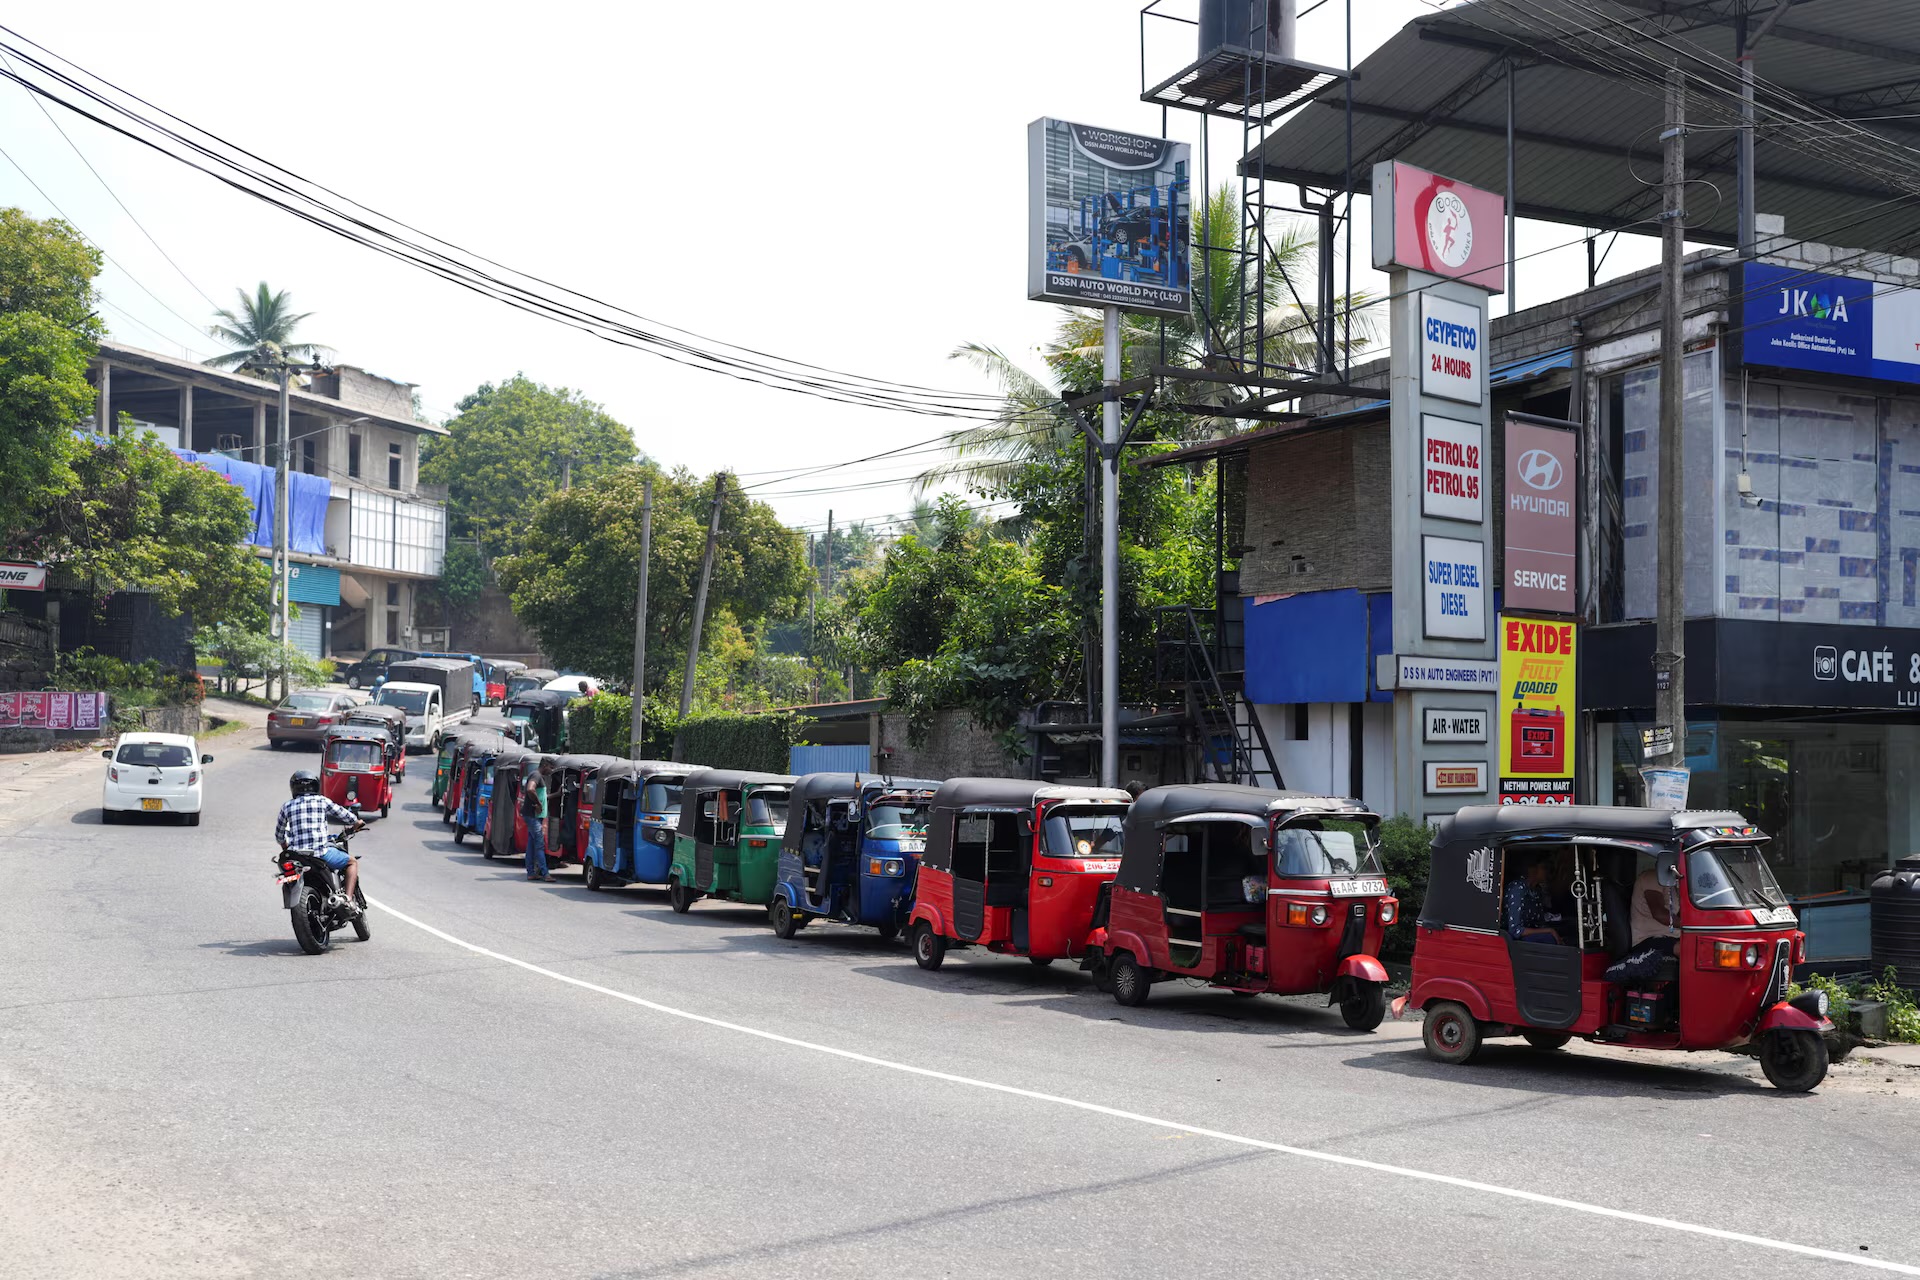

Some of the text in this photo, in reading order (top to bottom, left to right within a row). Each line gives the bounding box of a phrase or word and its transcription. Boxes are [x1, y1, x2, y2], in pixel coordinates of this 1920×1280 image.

[1088, 130, 1151, 149] WORKSHOP
[1099, 143, 1114, 151] AUTO
[1115, 146, 1134, 154] WORLD
[1460, 232, 1471, 260] LANKA
[1052, 276, 1182, 303] DSSN AUTO WORLD Pvt (Ltd)
[1426, 317, 1476, 351] CEYPETCO
[1790, 332, 1814, 342] Authorized
[1815, 335, 1829, 344] Dealer
[1771, 338, 1782, 346] John
[1783, 340, 1797, 348] Keells
[1797, 341, 1810, 349] Office
[1811, 343, 1836, 353] Automation
[1431, 353, 1471, 379] 24 HOURS
[1427, 438, 1479, 469] PETROL 92
[1427, 468, 1479, 499] PETROL 95
[1511, 493, 1569, 517] HYUNDAI
[1429, 560, 1479, 588] SUPER DIESEL
[1514, 569, 1566, 591] SERVICE
[1441, 592, 1468, 616] DIESEL
[1506, 621, 1572, 655] EXIDE
[1519, 658, 1564, 680] FULLY
[1841, 645, 1894, 683] CAFÉ
[1427, 668, 1444, 680] AUTO
[1445, 669, 1477, 682] ENGINEERS
[1478, 668, 1494, 683] (PVT)
[1513, 681, 1557, 699] LOADED
[1897, 690, 1920, 706] LU
[1432, 718, 1446, 734] AIR
[1452, 719, 1480, 734] WATER
[1527, 730, 1550, 740] EXIDE
[1504, 781, 1570, 791] NETHMI POWER MART
[1341, 882, 1358, 893] AAF
[1361, 881, 1385, 892] 6732
